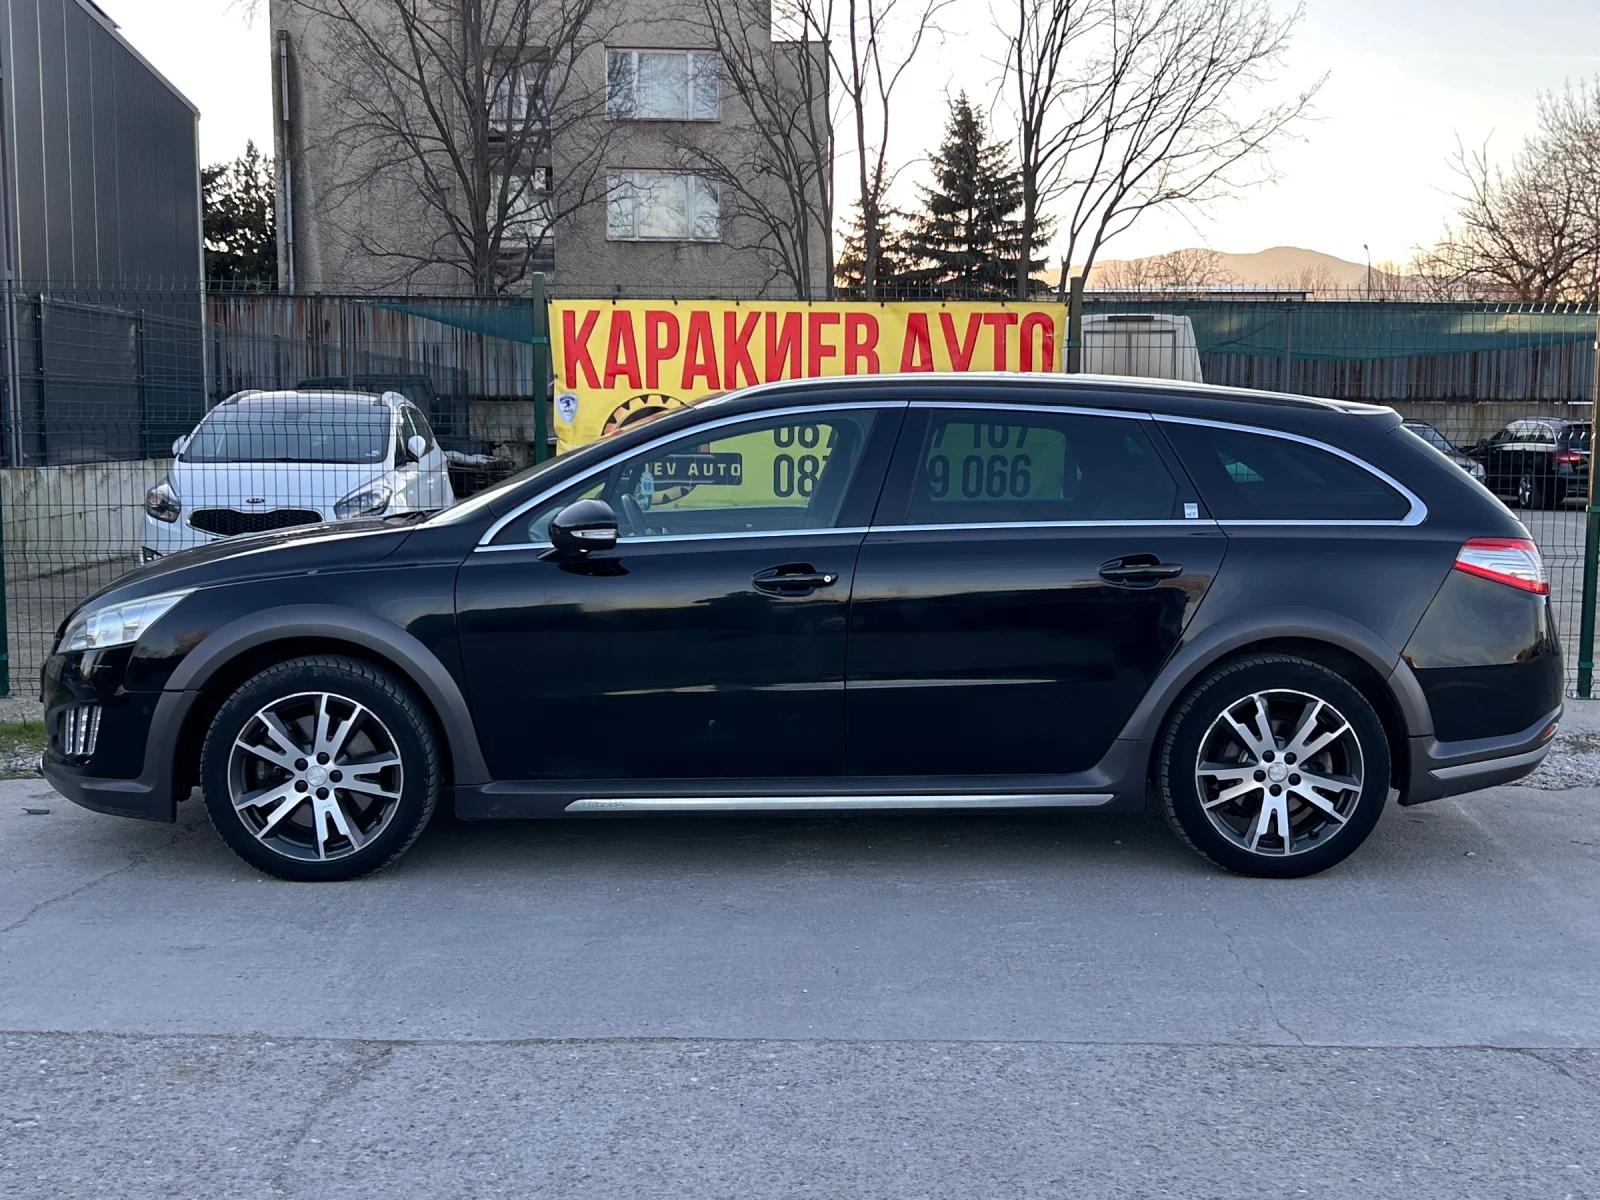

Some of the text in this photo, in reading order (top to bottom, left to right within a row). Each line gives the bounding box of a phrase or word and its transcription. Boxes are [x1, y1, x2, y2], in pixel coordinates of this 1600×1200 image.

[562, 309, 880, 390] КАРАКИЕВ
[687, 462, 742, 477] AUTO
[961, 454, 1032, 499] 066
